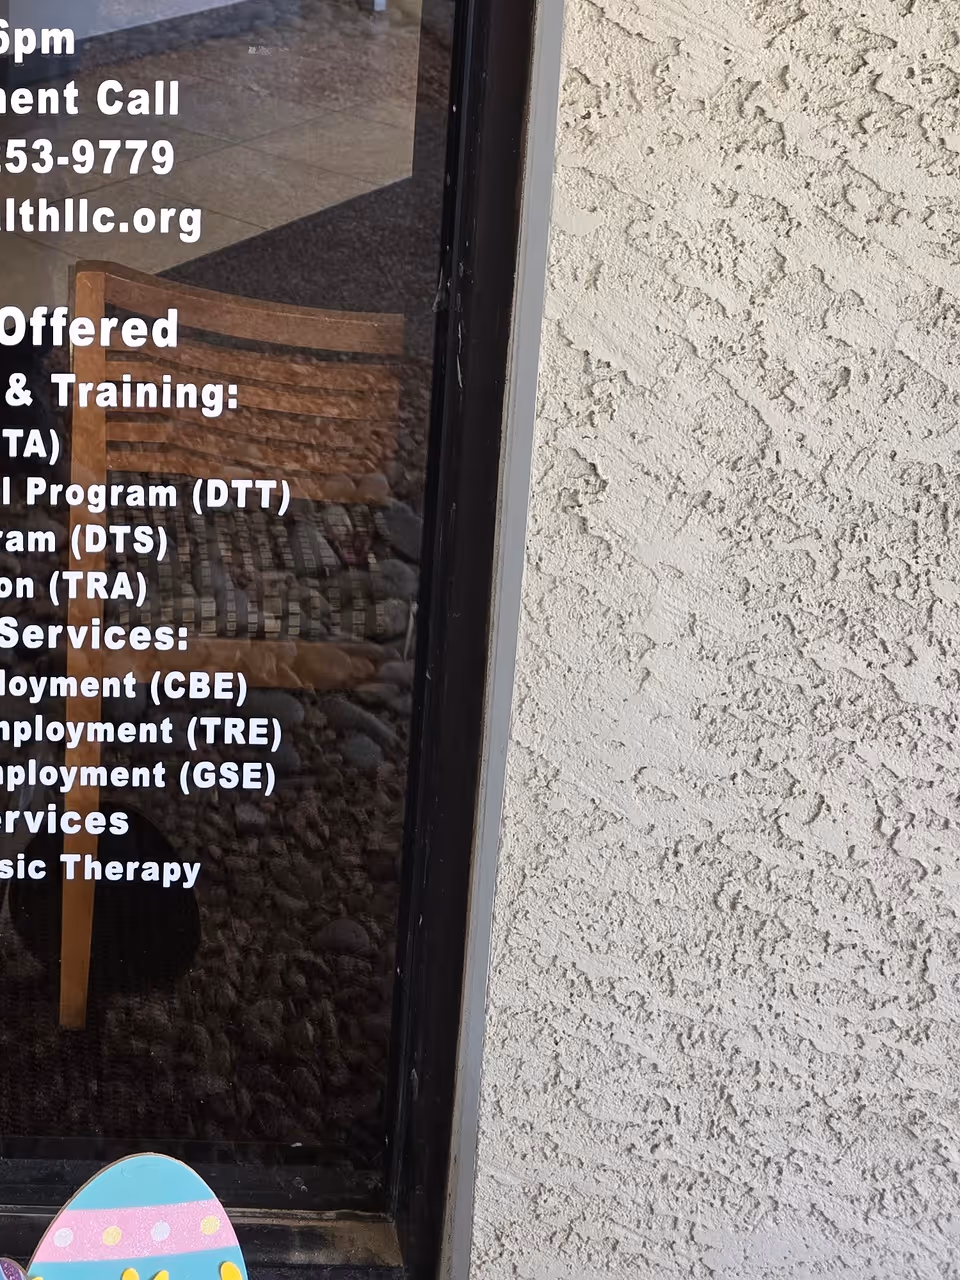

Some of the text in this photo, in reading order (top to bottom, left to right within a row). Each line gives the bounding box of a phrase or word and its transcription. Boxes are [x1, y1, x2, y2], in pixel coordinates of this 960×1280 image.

[96, 79, 179, 116] Call
[5, 372, 33, 407] &
[50, 373, 238, 418] Training:
[26, 476, 177, 514] Program
[192, 478, 291, 516] (DTT)
[71, 524, 168, 562] (DTS)
[49, 570, 147, 607] (TRA)
[150, 670, 247, 707] (CBE)
[187, 716, 282, 753] (TRE)
[180, 761, 275, 797] (GSE)
[59, 853, 201, 889] Therapy
